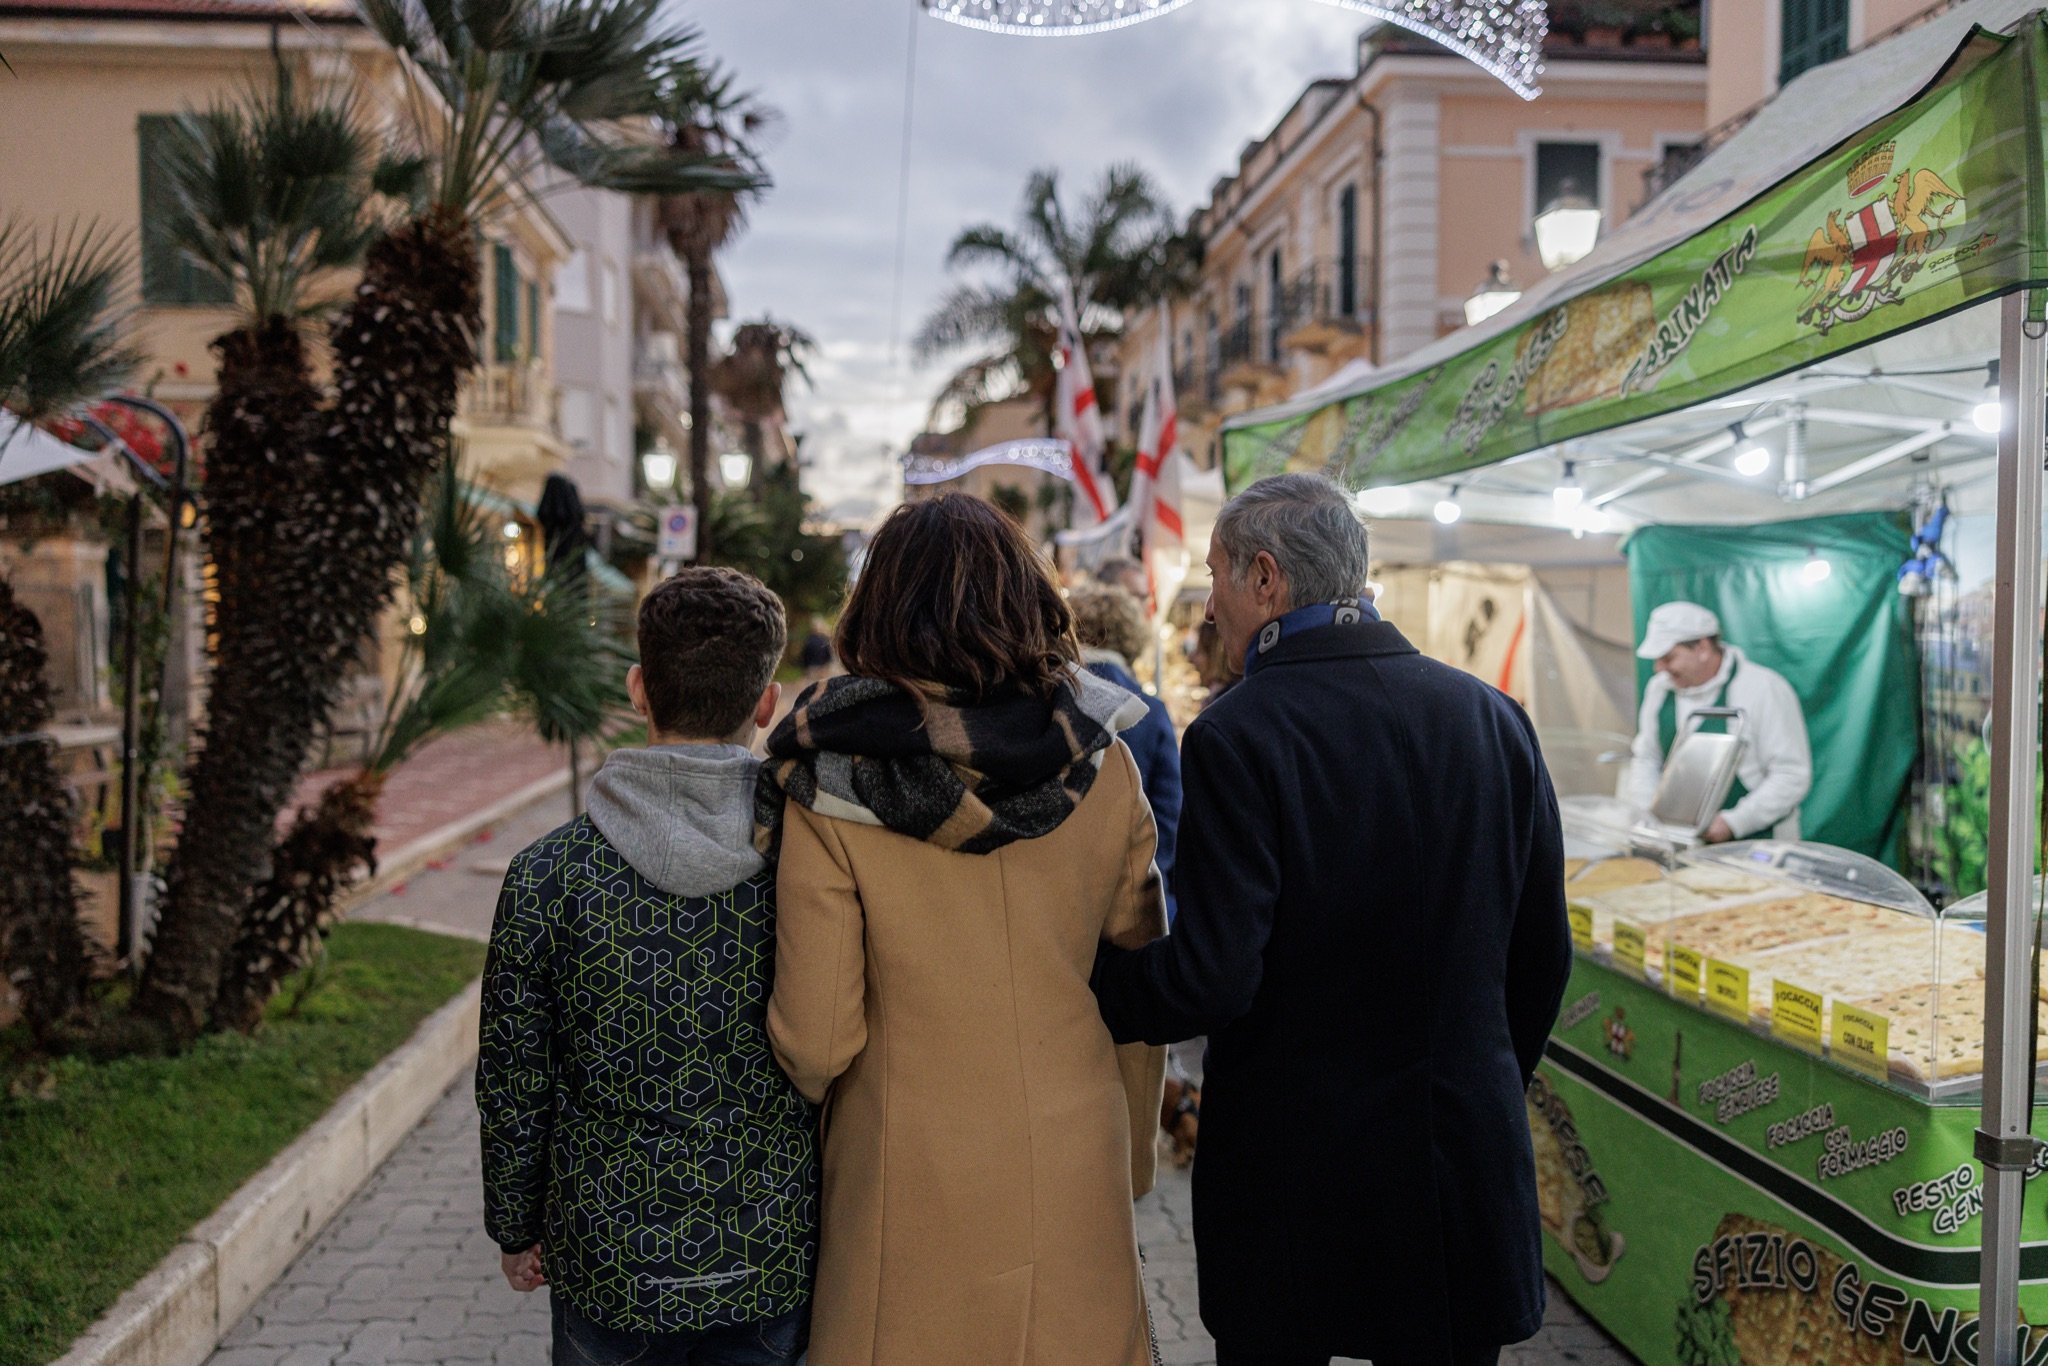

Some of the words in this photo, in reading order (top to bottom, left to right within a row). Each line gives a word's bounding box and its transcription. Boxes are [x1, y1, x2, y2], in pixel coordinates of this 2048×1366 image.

[1766, 1102, 1835, 1149] FOCACCIA
[1823, 1125, 1851, 1150] CON
[1817, 1126, 1909, 1180] FORMAGGIO
[1893, 1163, 1974, 1216] PESTO
[1692, 1231, 1819, 1303] SFIZIO
